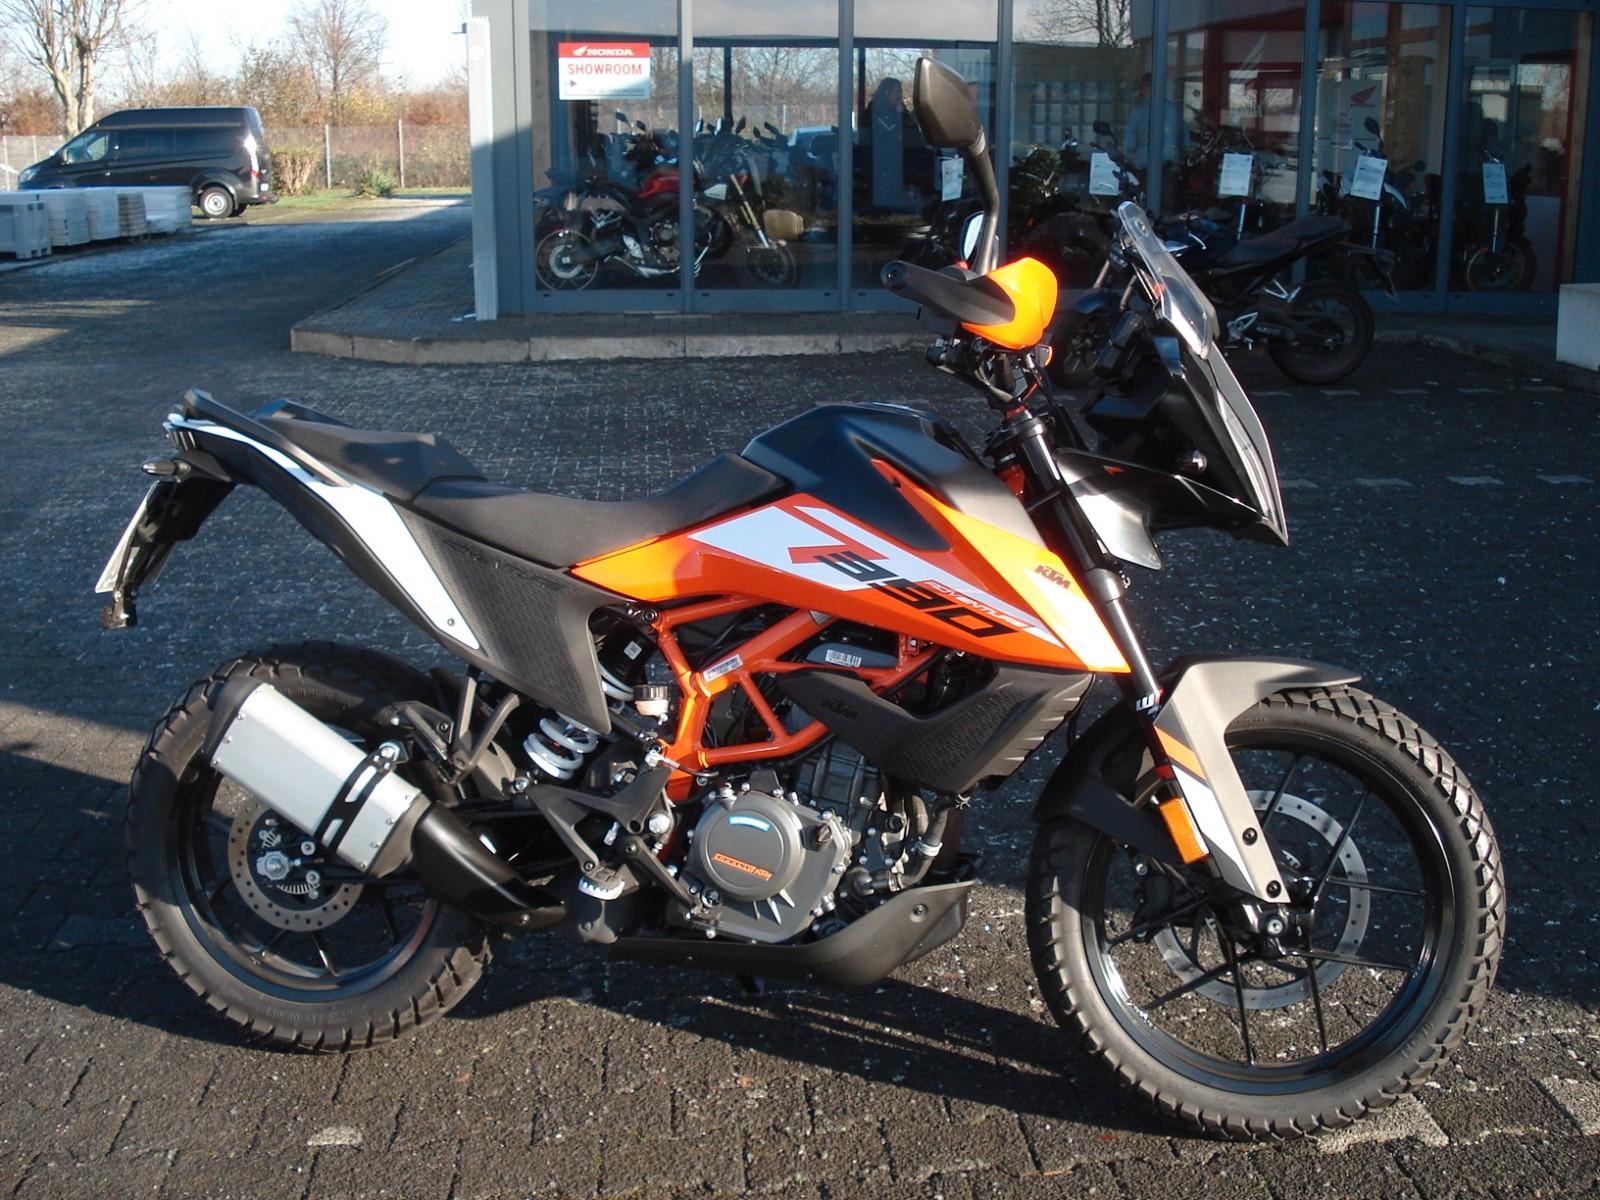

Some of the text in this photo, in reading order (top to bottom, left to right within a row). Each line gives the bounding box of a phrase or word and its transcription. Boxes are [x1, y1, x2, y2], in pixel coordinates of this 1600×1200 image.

[587, 48, 634, 56] HONDA
[567, 63, 642, 75] SHOWROOM
[1034, 565, 1071, 589] KTM
[813, 550, 1020, 638] 390
